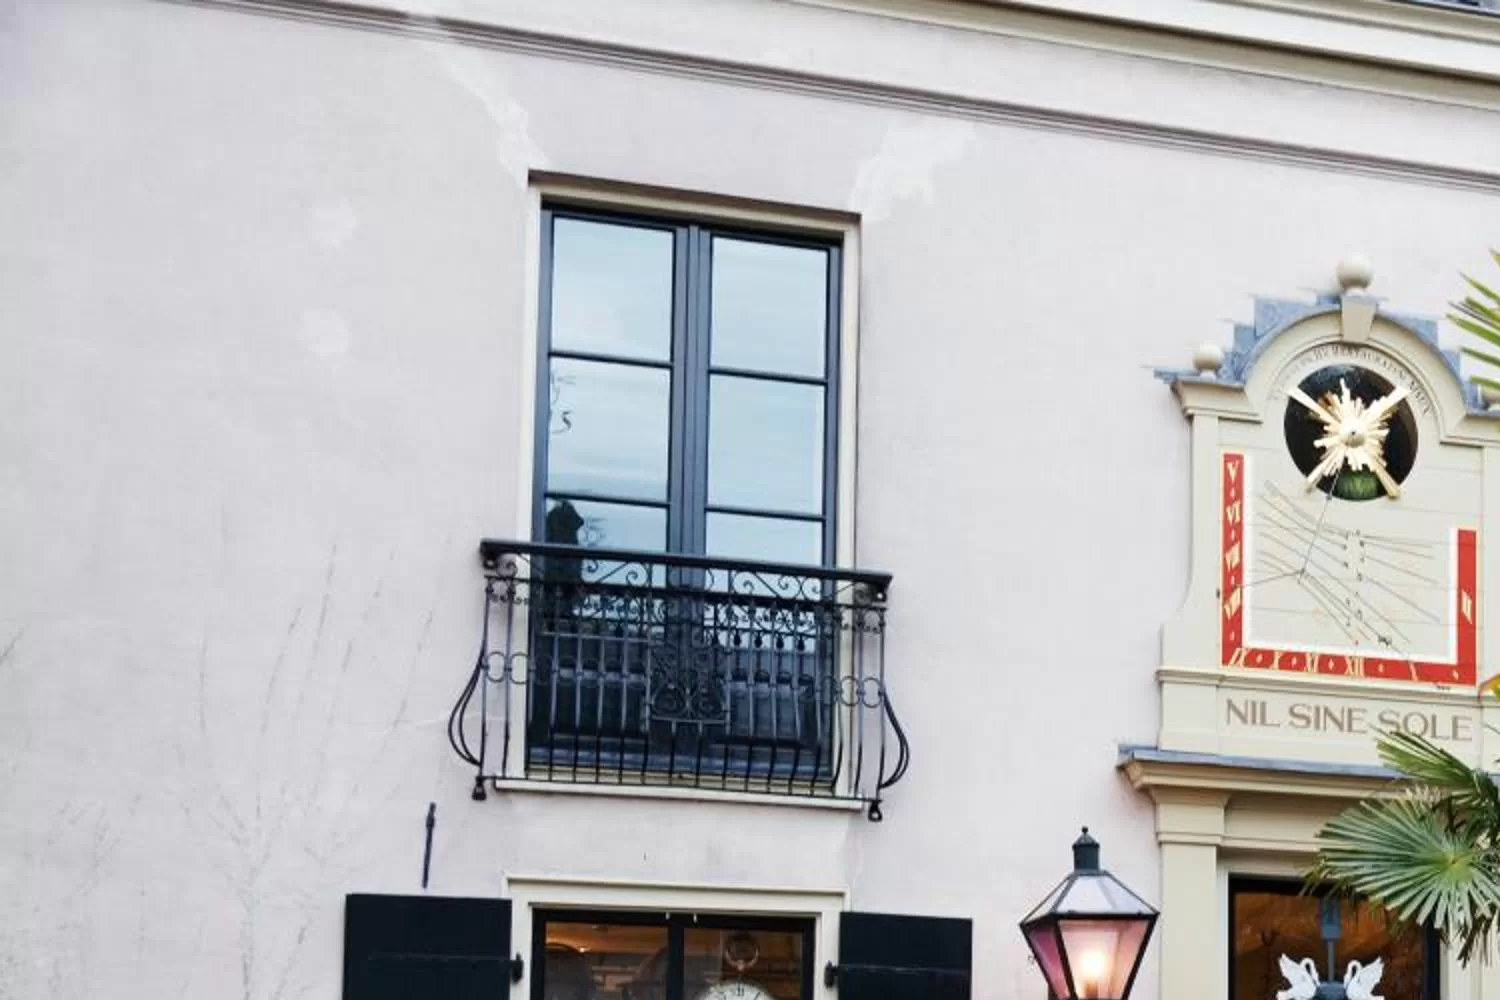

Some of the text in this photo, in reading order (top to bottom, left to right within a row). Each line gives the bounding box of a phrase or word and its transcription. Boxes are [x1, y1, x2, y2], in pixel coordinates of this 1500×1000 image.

[1227, 461, 1239, 482] V
[1226, 501, 1240, 524] VI
[1229, 648, 1246, 668] IX
[1304, 653, 1319, 673] XI
[1344, 655, 1364, 676] XII
[1226, 699, 1473, 741] NIL SINE SOLE
